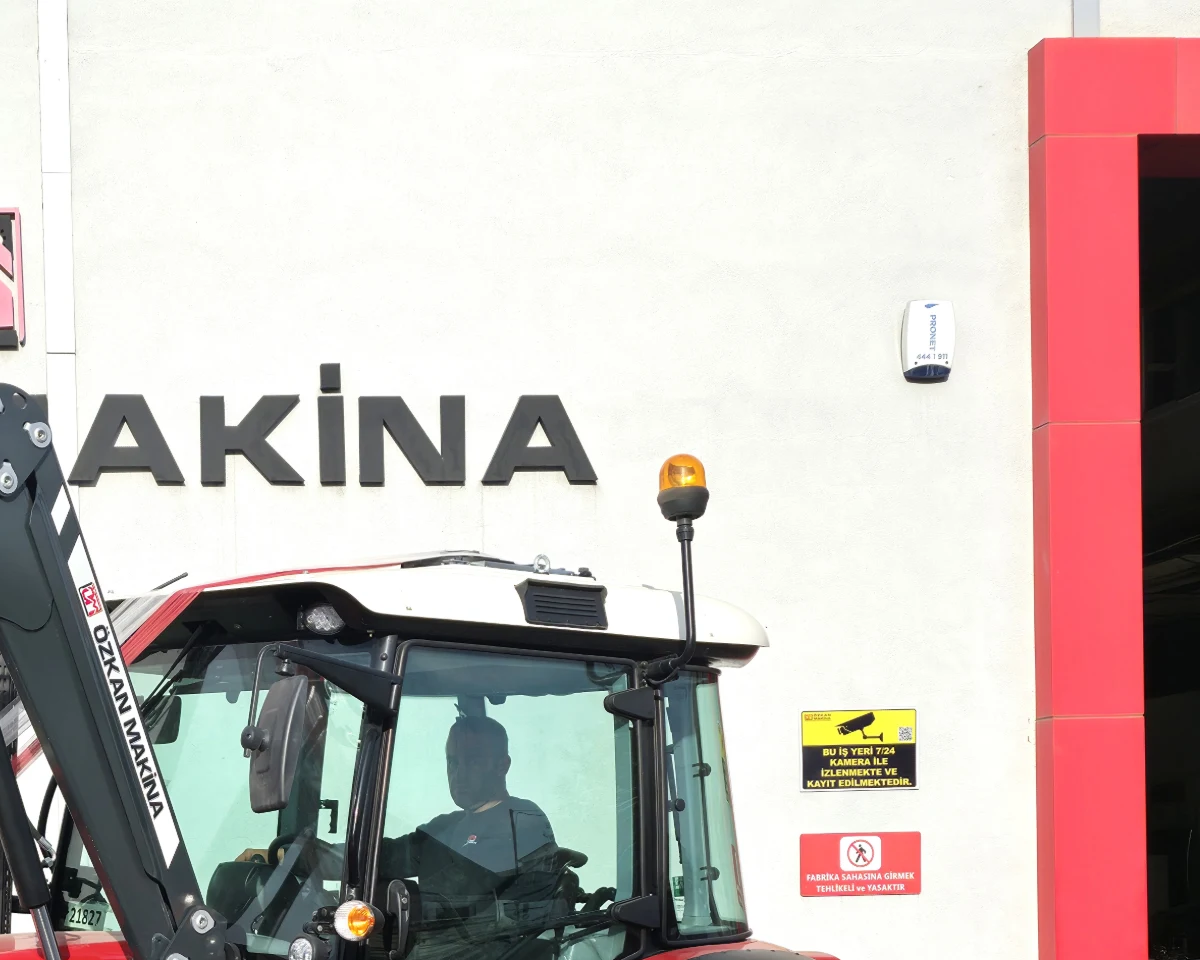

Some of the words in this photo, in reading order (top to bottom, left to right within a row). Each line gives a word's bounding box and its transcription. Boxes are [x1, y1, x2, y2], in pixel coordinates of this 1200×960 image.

[929, 314, 937, 352] PRONET
[93, 624, 132, 715] ÖZKAN
[123, 717, 165, 820] MAKİNA
[822, 748, 836, 756] BU
[839, 747, 849, 757] İŞ
[851, 746, 873, 756] YERİ
[876, 747, 896, 755] 7/24
[830, 758, 871, 767] KAMERA
[873, 757, 889, 766] İLE
[821, 768, 882, 777] İZLENMEKTE
[885, 768, 898, 776] VE
[807, 780, 836, 788] KAYIT
[806, 872, 840, 881] FABRİKA
[841, 872, 882, 881] SAHASINA
[884, 871, 915, 880] GİRMEK
[816, 883, 855, 893] TEHLİKELİ
[867, 883, 905, 891] YASAKTIR
[68, 907, 102, 926] 21827
